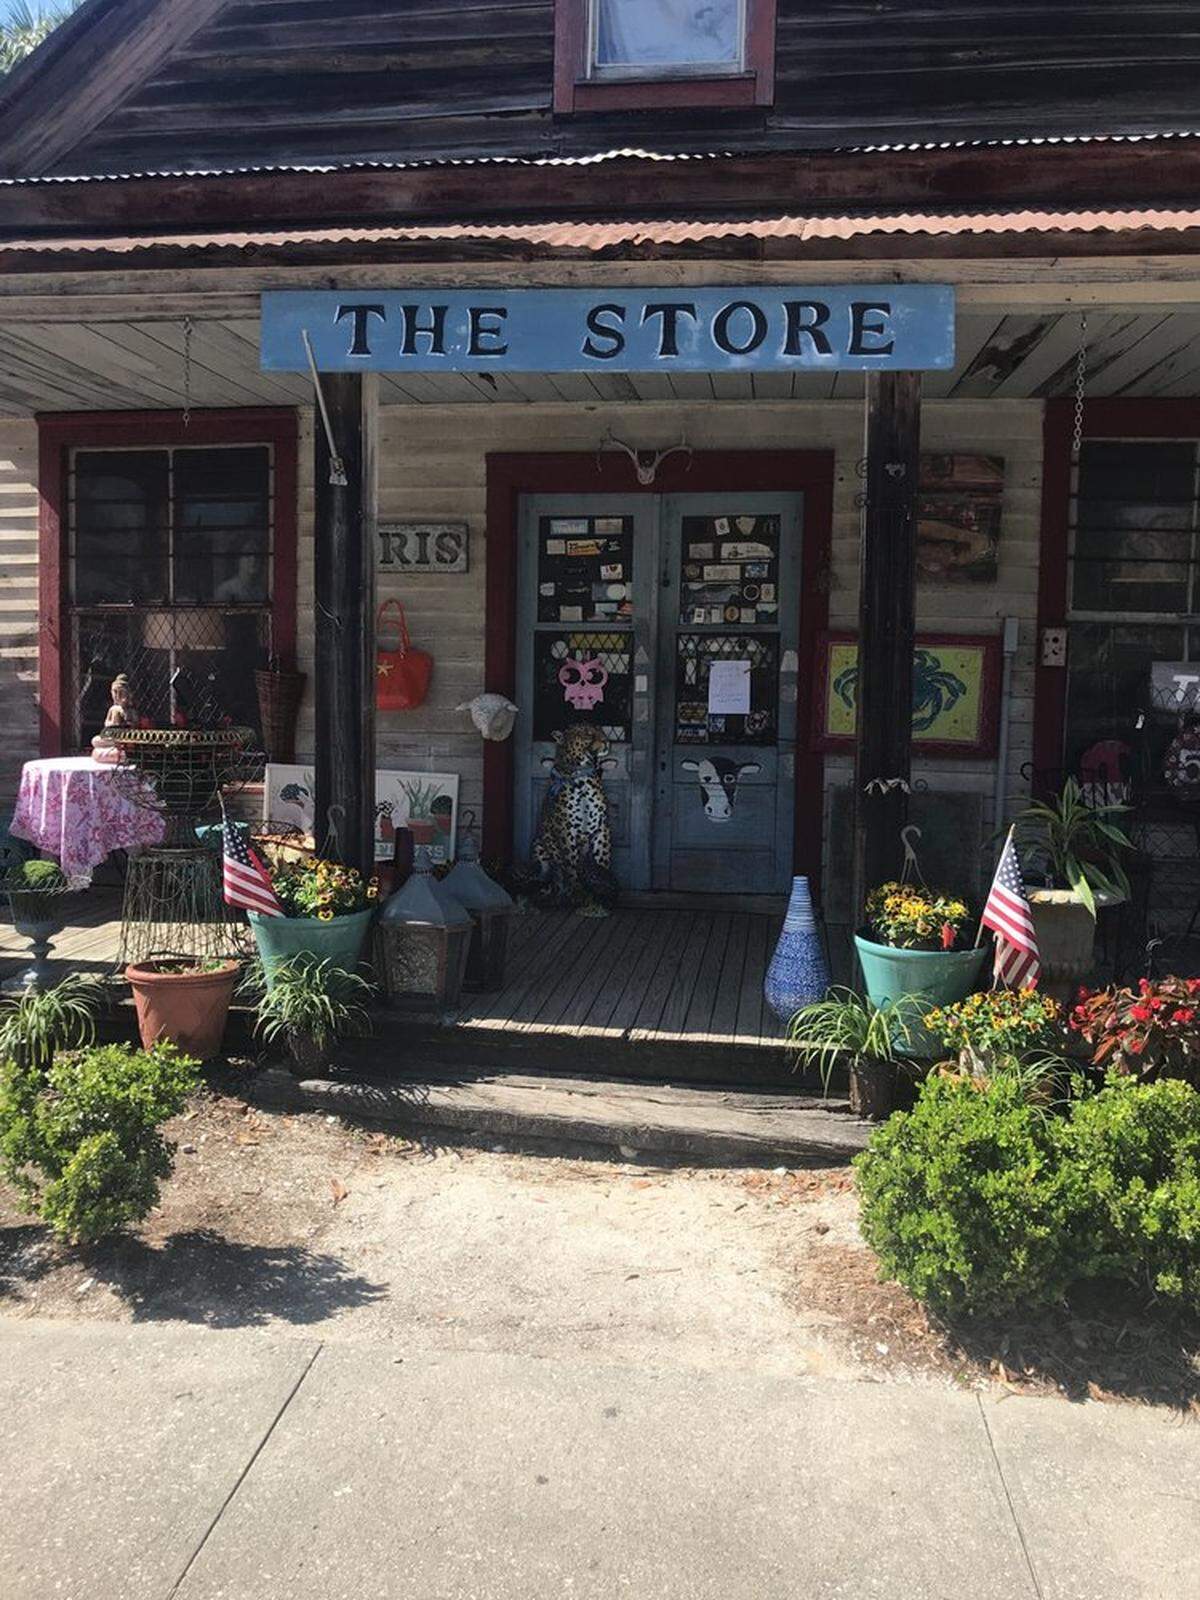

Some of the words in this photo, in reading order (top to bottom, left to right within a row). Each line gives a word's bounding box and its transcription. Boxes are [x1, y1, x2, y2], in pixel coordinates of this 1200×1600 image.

[333, 303, 508, 358] THE
[580, 301, 895, 360] STORE
[1172, 674, 1200, 704] T
